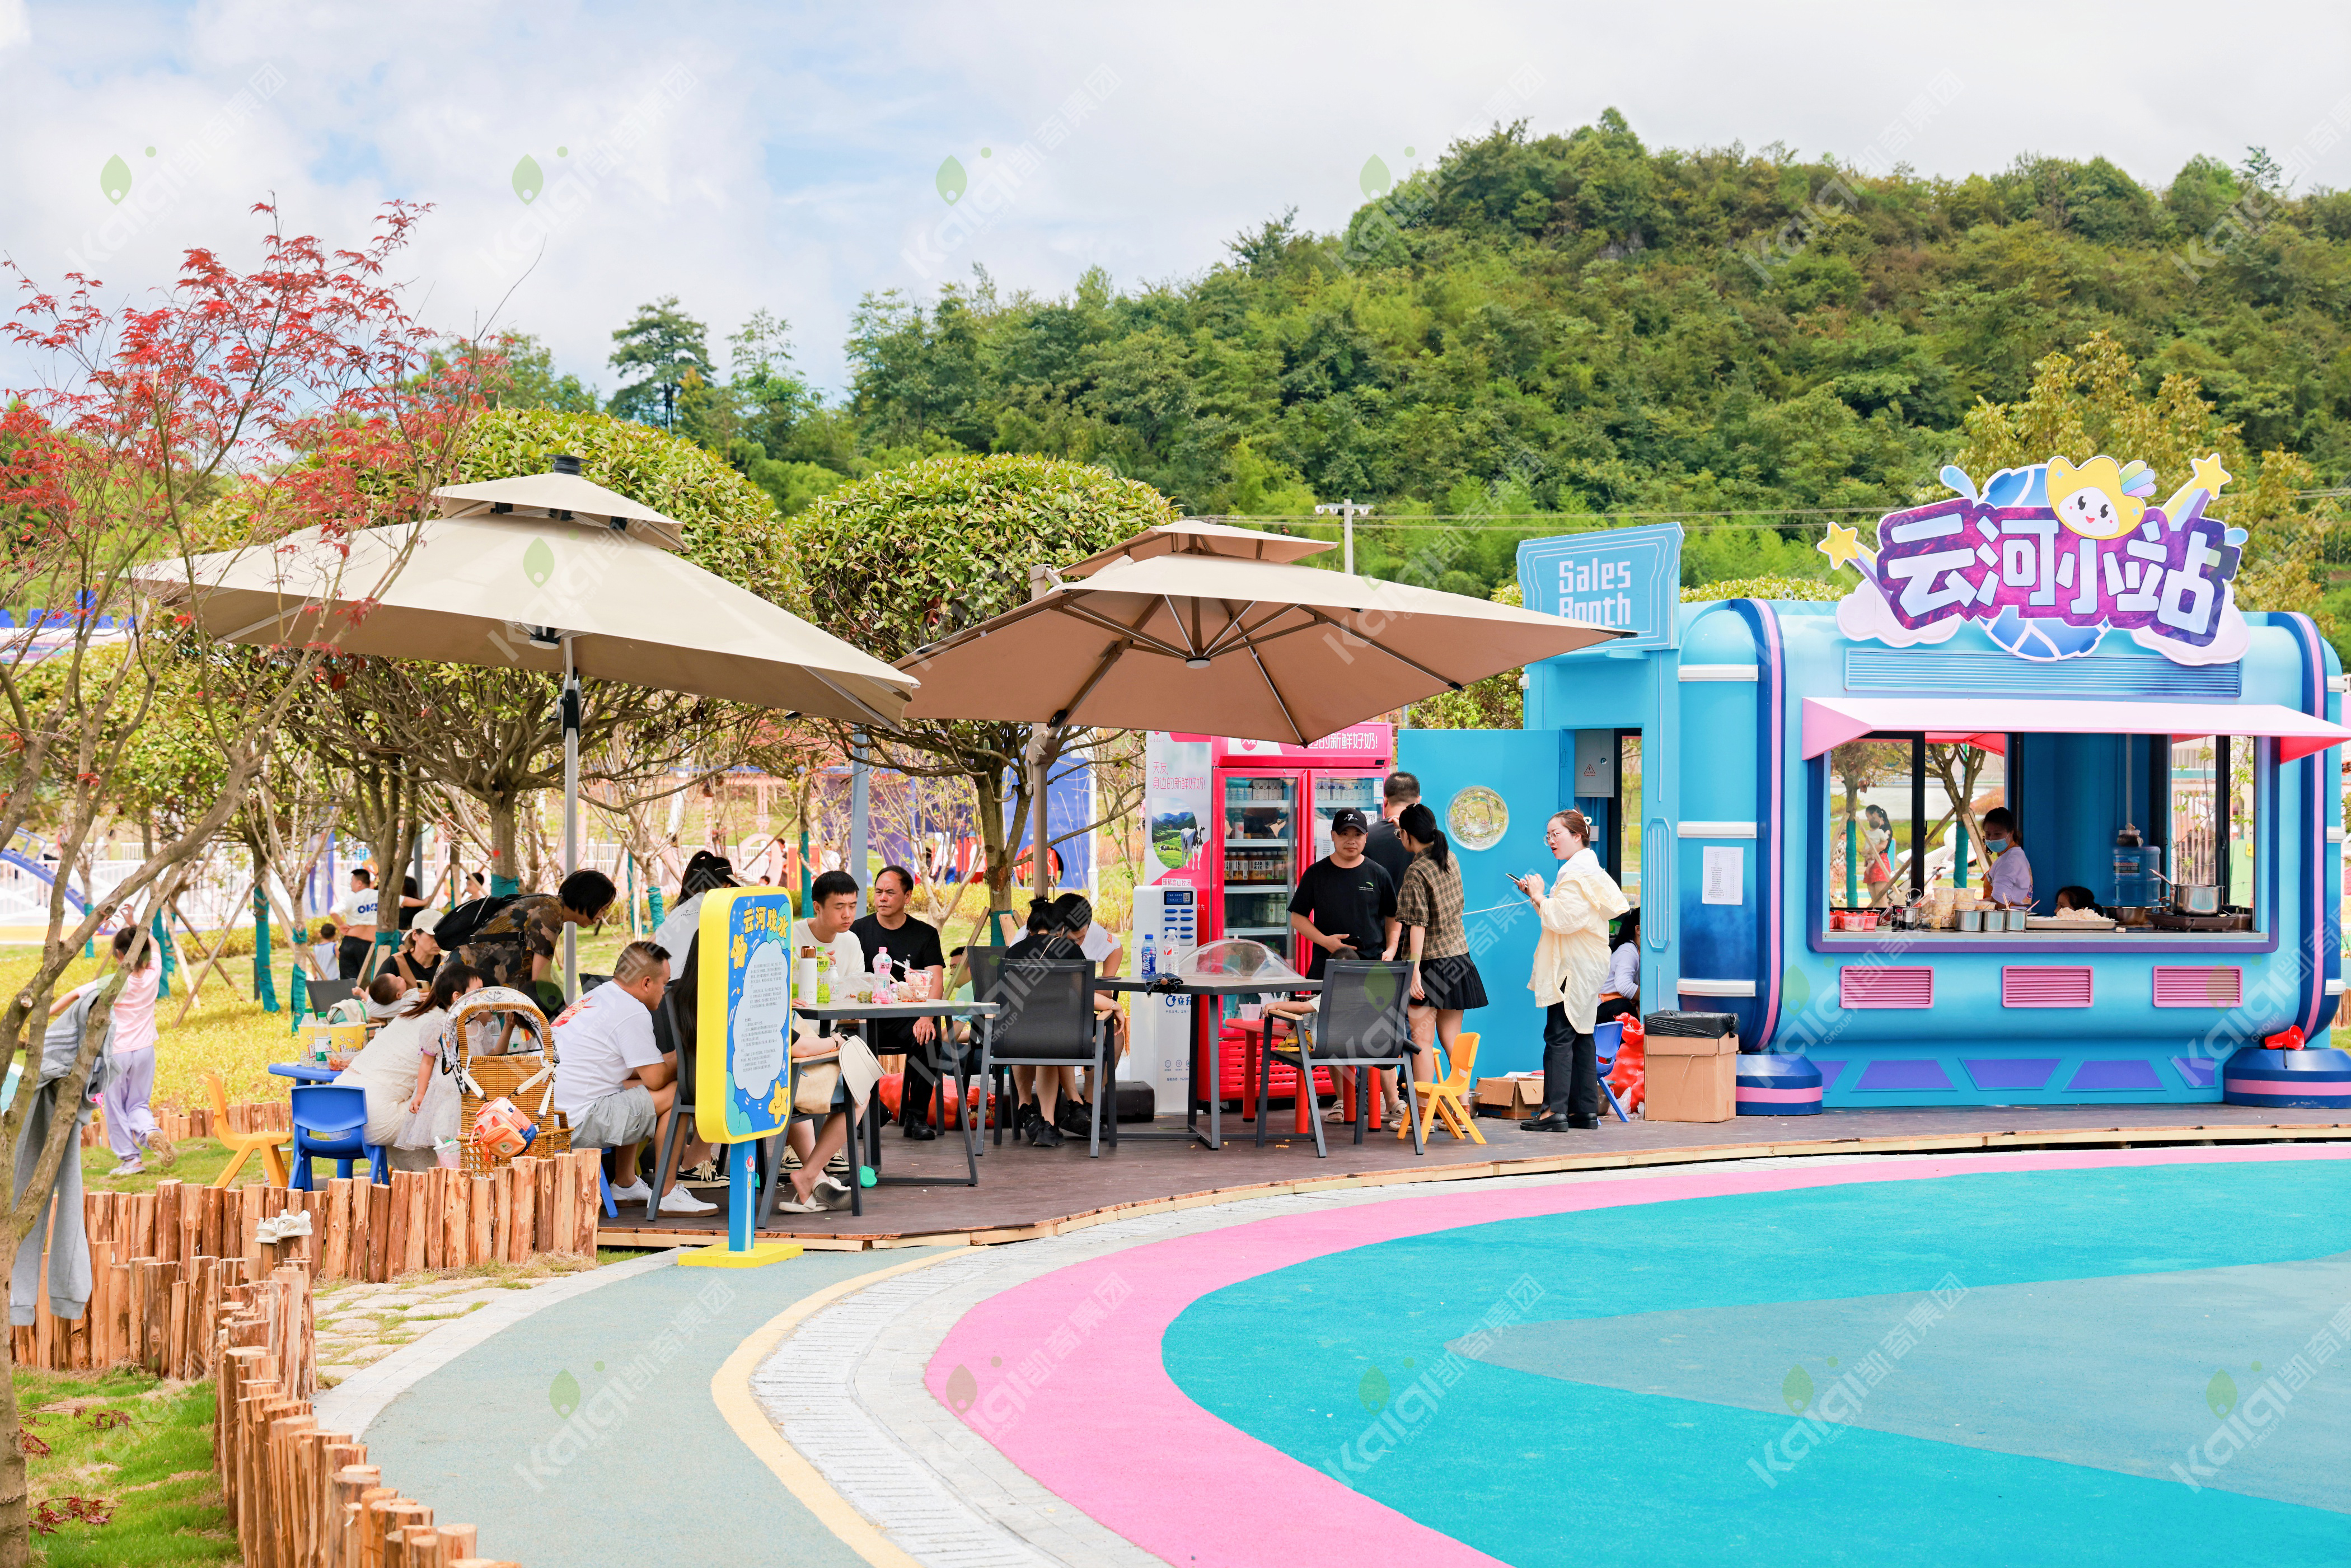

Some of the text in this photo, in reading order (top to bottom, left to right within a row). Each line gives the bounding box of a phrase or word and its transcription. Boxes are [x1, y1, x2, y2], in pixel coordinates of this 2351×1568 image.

[1559, 558, 1631, 593] Sales
[1887, 512, 2222, 635] 云河小站
[1559, 592, 1631, 626] Booth
[1296, 732, 1378, 750] 的新鲜好奶！
[1153, 777, 1205, 790] 身边的新鲜好奶！
[743, 905, 789, 939] 云河戏水
